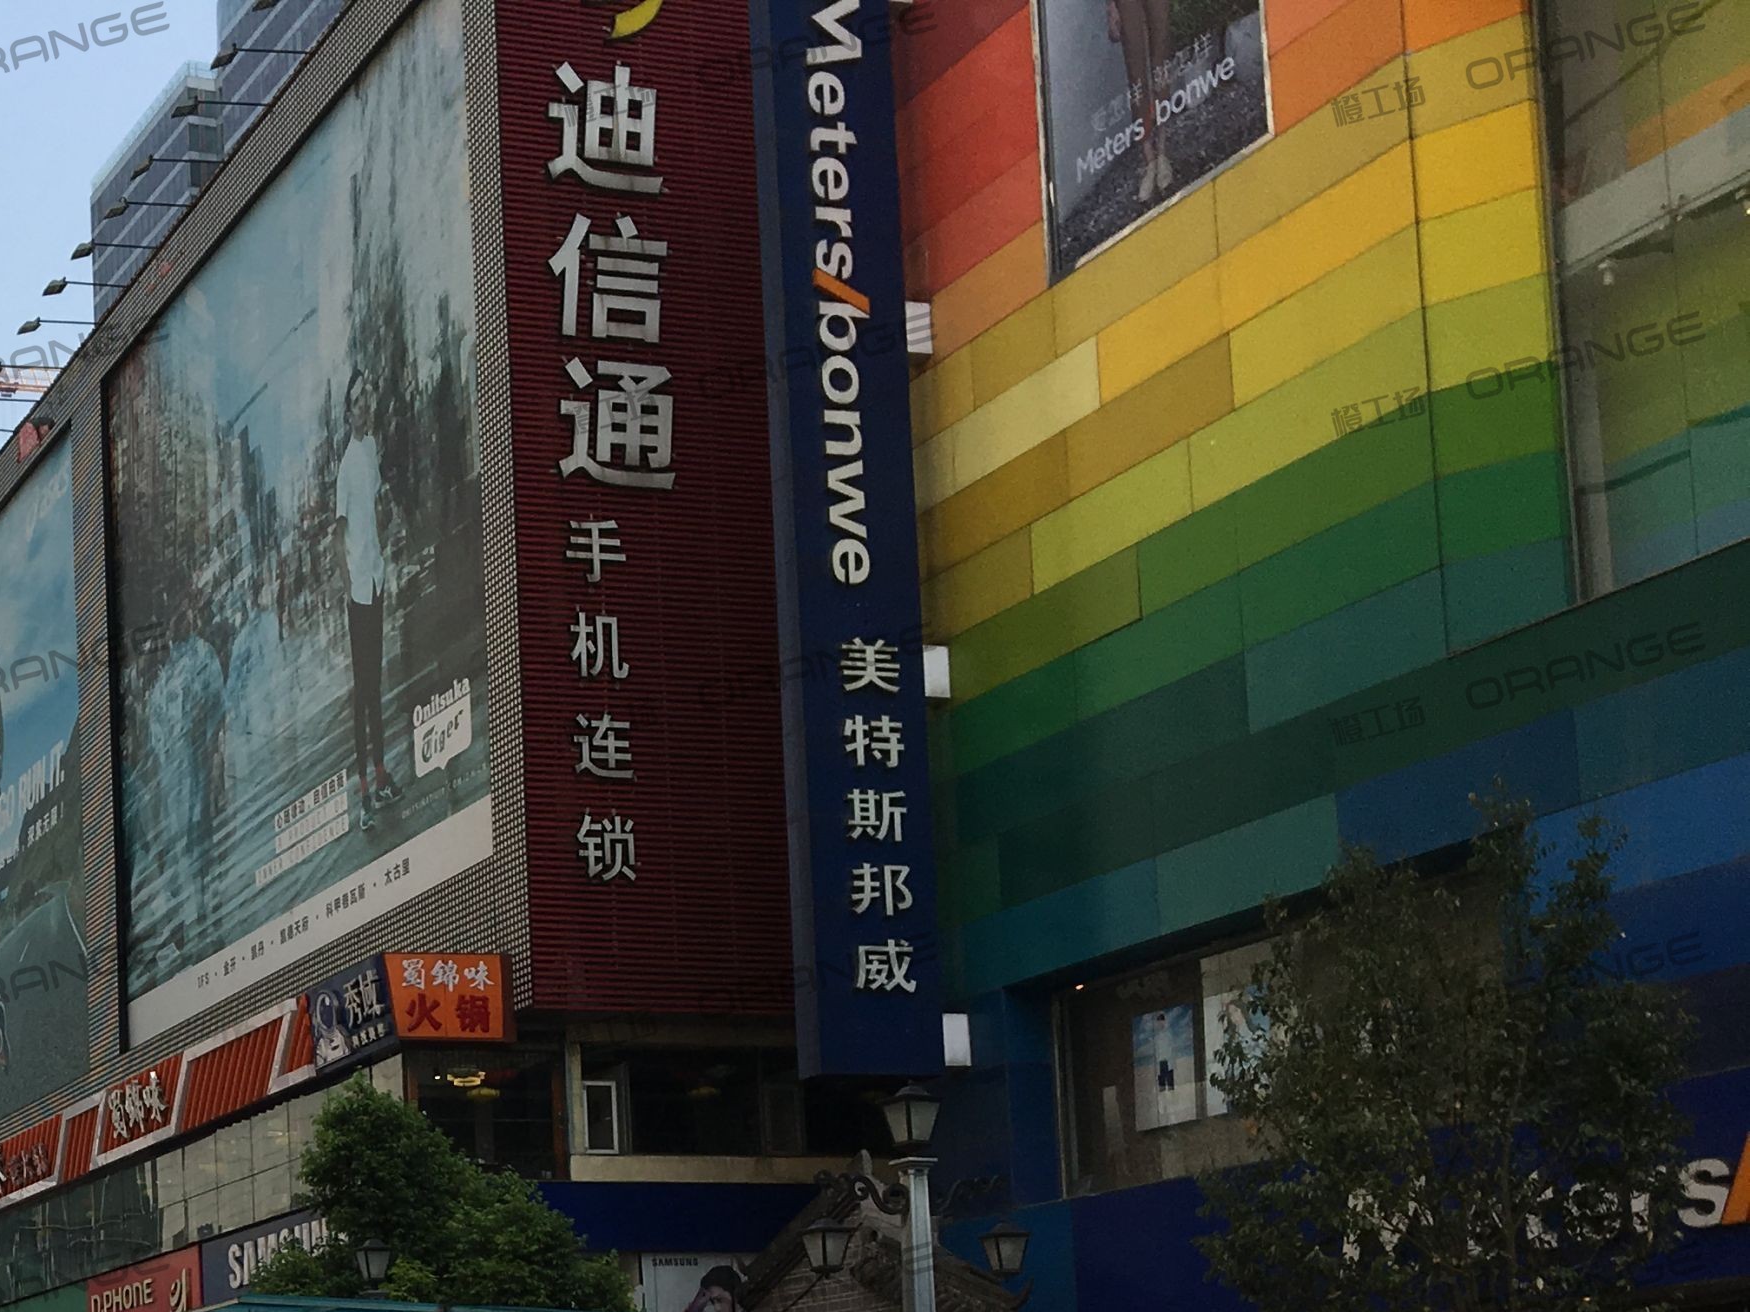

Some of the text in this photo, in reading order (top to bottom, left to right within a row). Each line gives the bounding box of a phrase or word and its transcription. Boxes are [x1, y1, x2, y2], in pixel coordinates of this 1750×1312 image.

[1076, 56, 1235, 183] Meters bonwe
[547, 61, 676, 490] 迪信通
[413, 677, 470, 727] Onitsuka
[421, 709, 464, 763] Tiger
[565, 516, 637, 882] 手机连锁
[19, 755, 46, 814] RUN
[840, 637, 917, 992] 美特斯邦威
[652, 1257, 699, 1267] SAMSUNG
